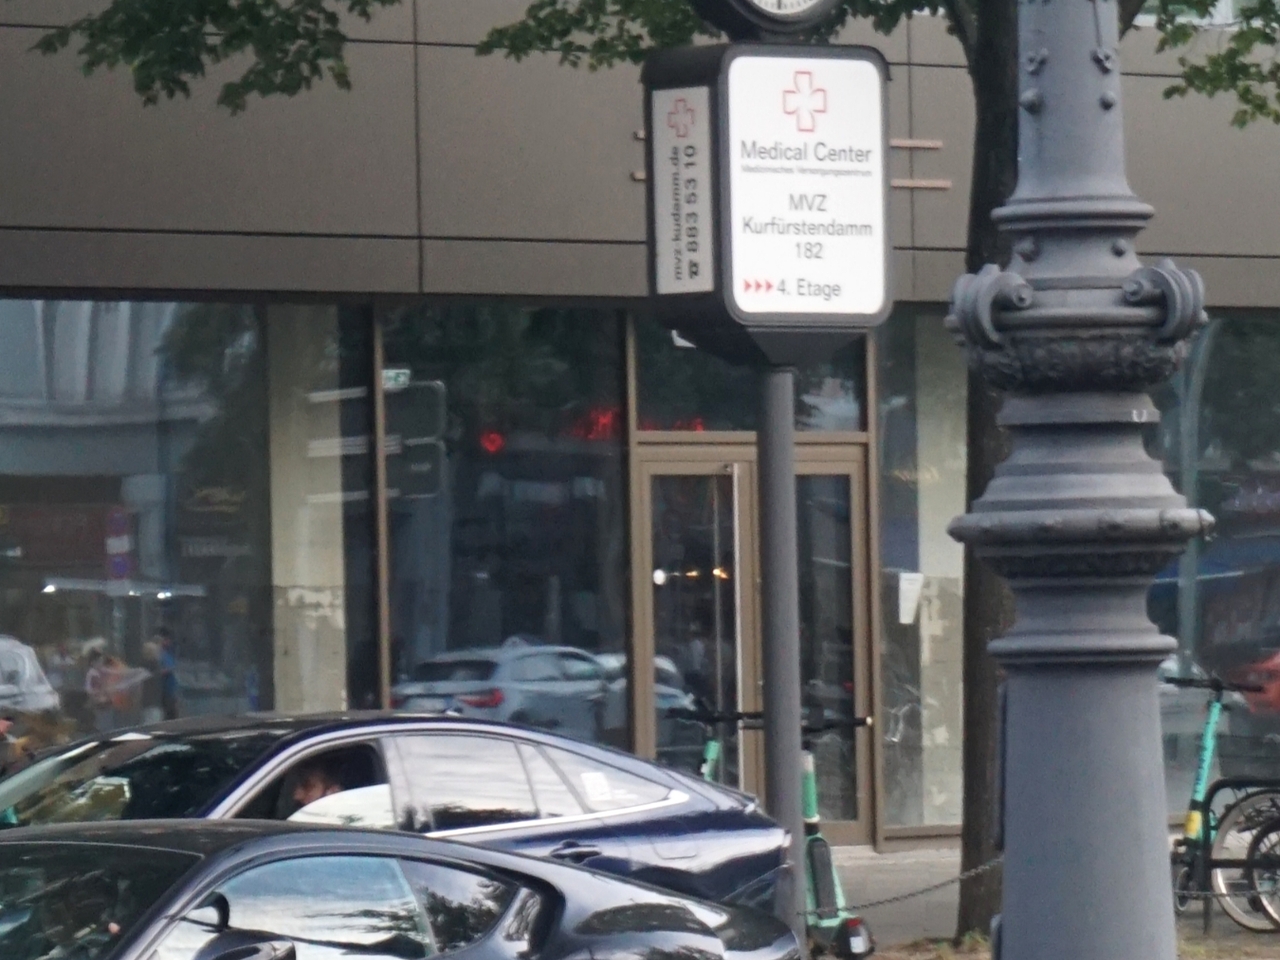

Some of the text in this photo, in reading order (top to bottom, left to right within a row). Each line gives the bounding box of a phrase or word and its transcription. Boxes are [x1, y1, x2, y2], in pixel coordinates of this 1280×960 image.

[740, 139, 872, 163] Medical Center
[683, 145, 699, 252] 883 53 10
[789, 193, 828, 213] MVZ
[742, 215, 873, 237] Kurfürstendamm
[795, 241, 824, 260] 182
[776, 278, 842, 301] 4. Etage
